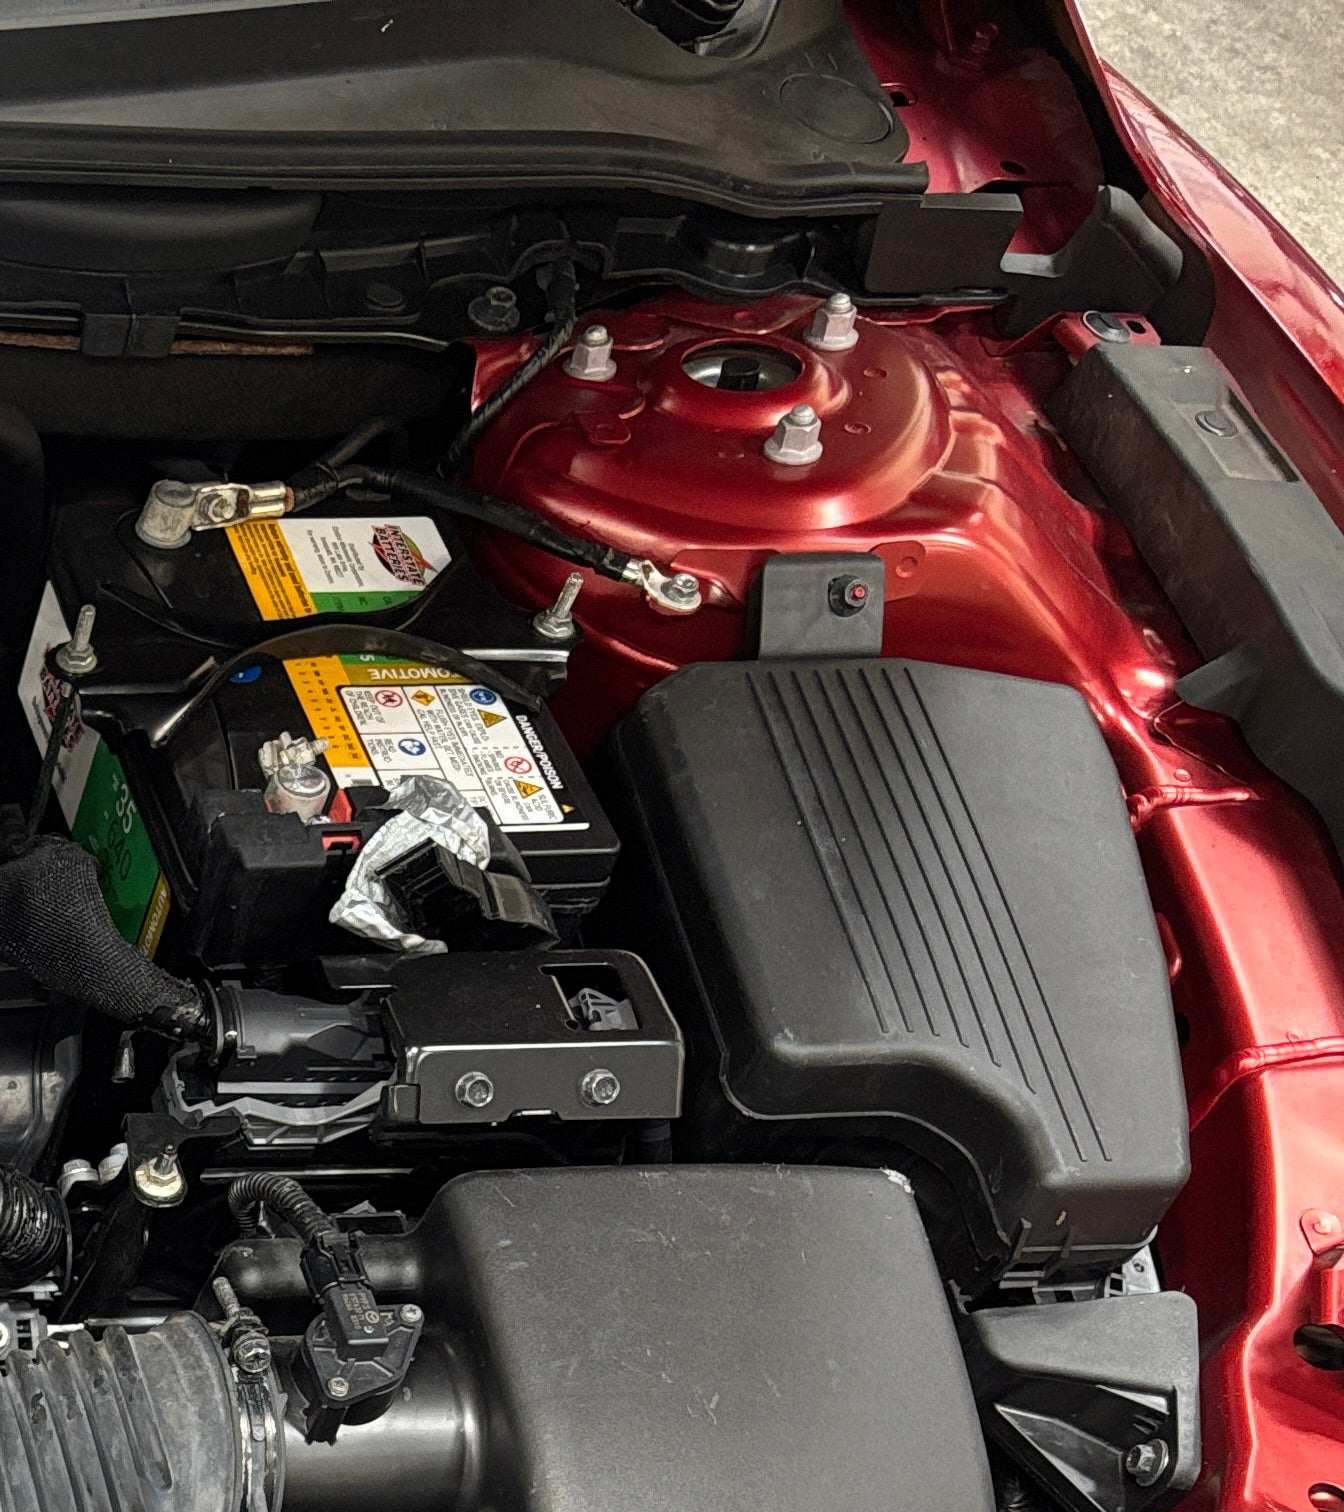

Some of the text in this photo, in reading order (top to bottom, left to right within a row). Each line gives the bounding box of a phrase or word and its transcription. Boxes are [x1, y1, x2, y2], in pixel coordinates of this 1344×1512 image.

[374, 527, 408, 581] BATTERIES
[387, 524, 426, 586] INTERSTATE
[515, 714, 564, 790] DANGER/POISON
